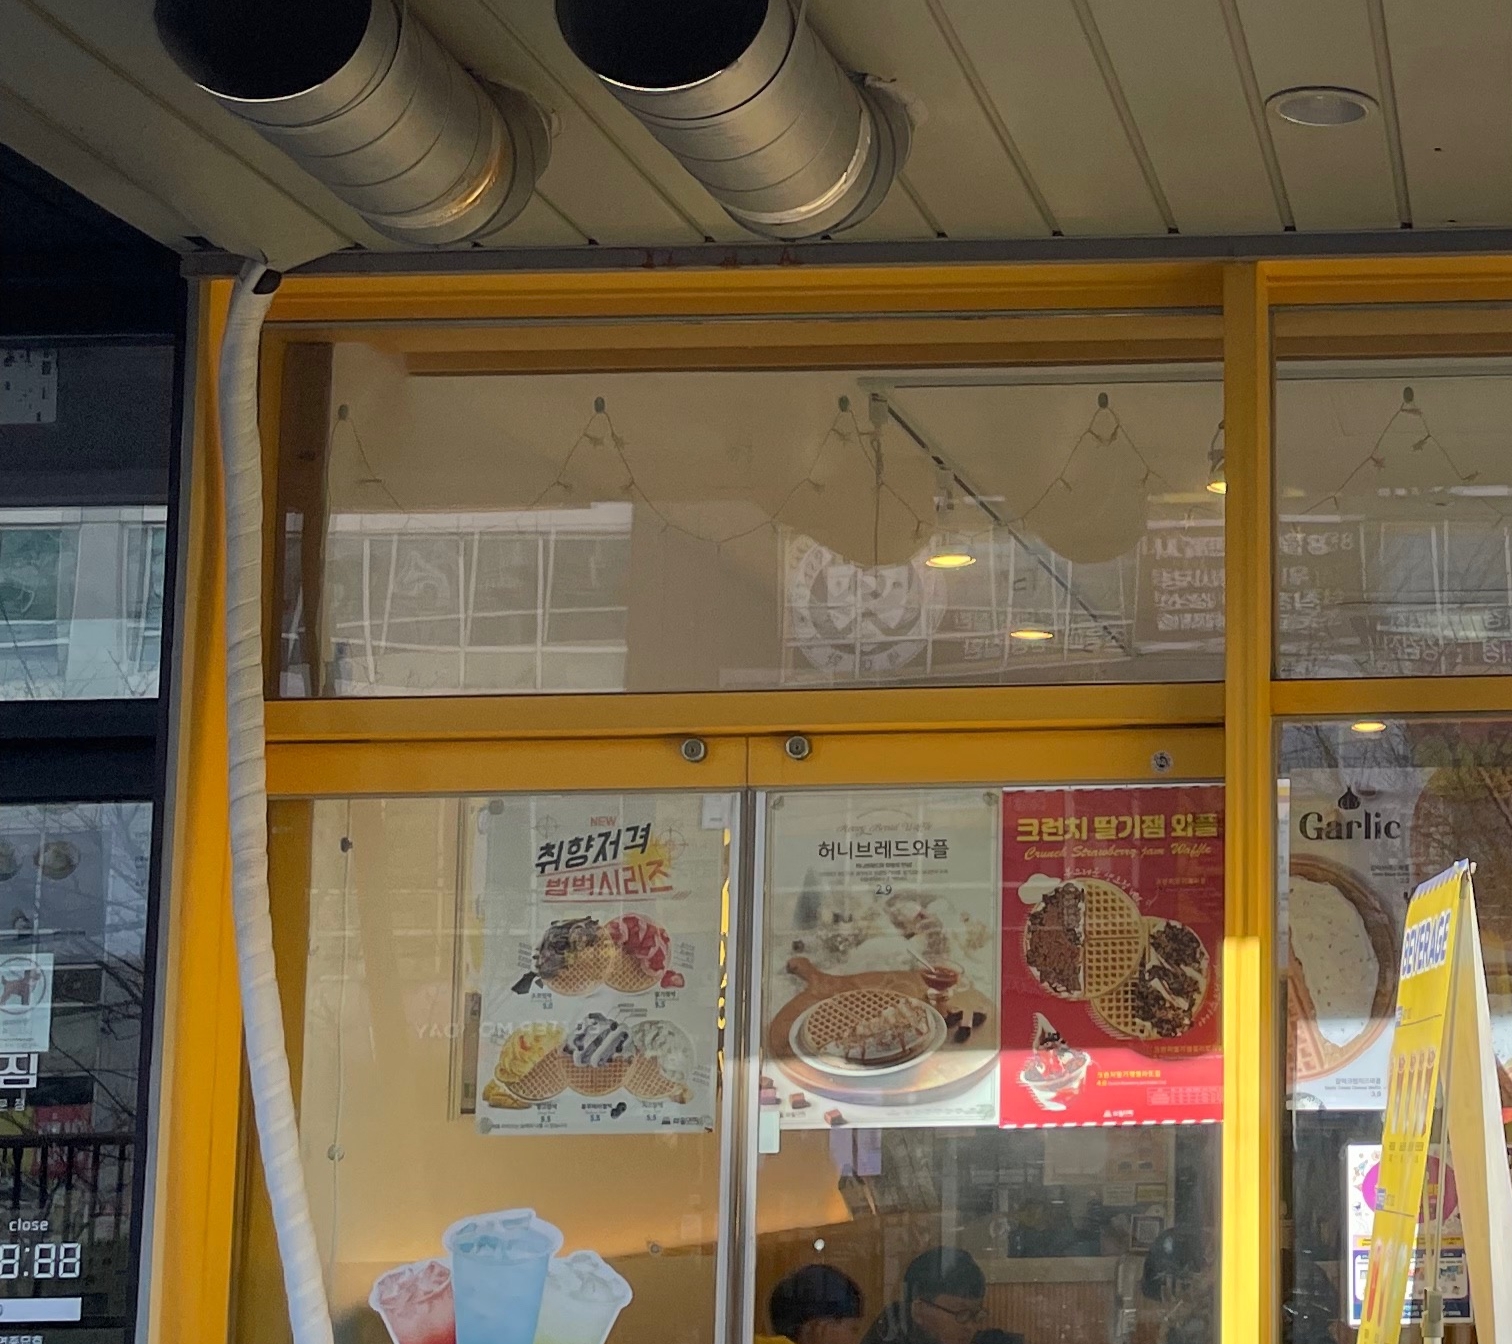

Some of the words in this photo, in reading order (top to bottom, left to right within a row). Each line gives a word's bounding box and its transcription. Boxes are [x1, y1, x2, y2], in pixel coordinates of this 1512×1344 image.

[590, 816, 617, 827] NEW
[1016, 816, 1088, 842] 크런치
[1094, 813, 1165, 840] 딸기잼
[1170, 813, 1218, 837] 와플
[1299, 809, 1401, 841] Garlic
[535, 822, 651, 874] 취향저격
[818, 839, 949, 861] 허니브레드와플
[1401, 909, 1451, 980] BEVERAGE
[9, 1218, 49, 1231] close
